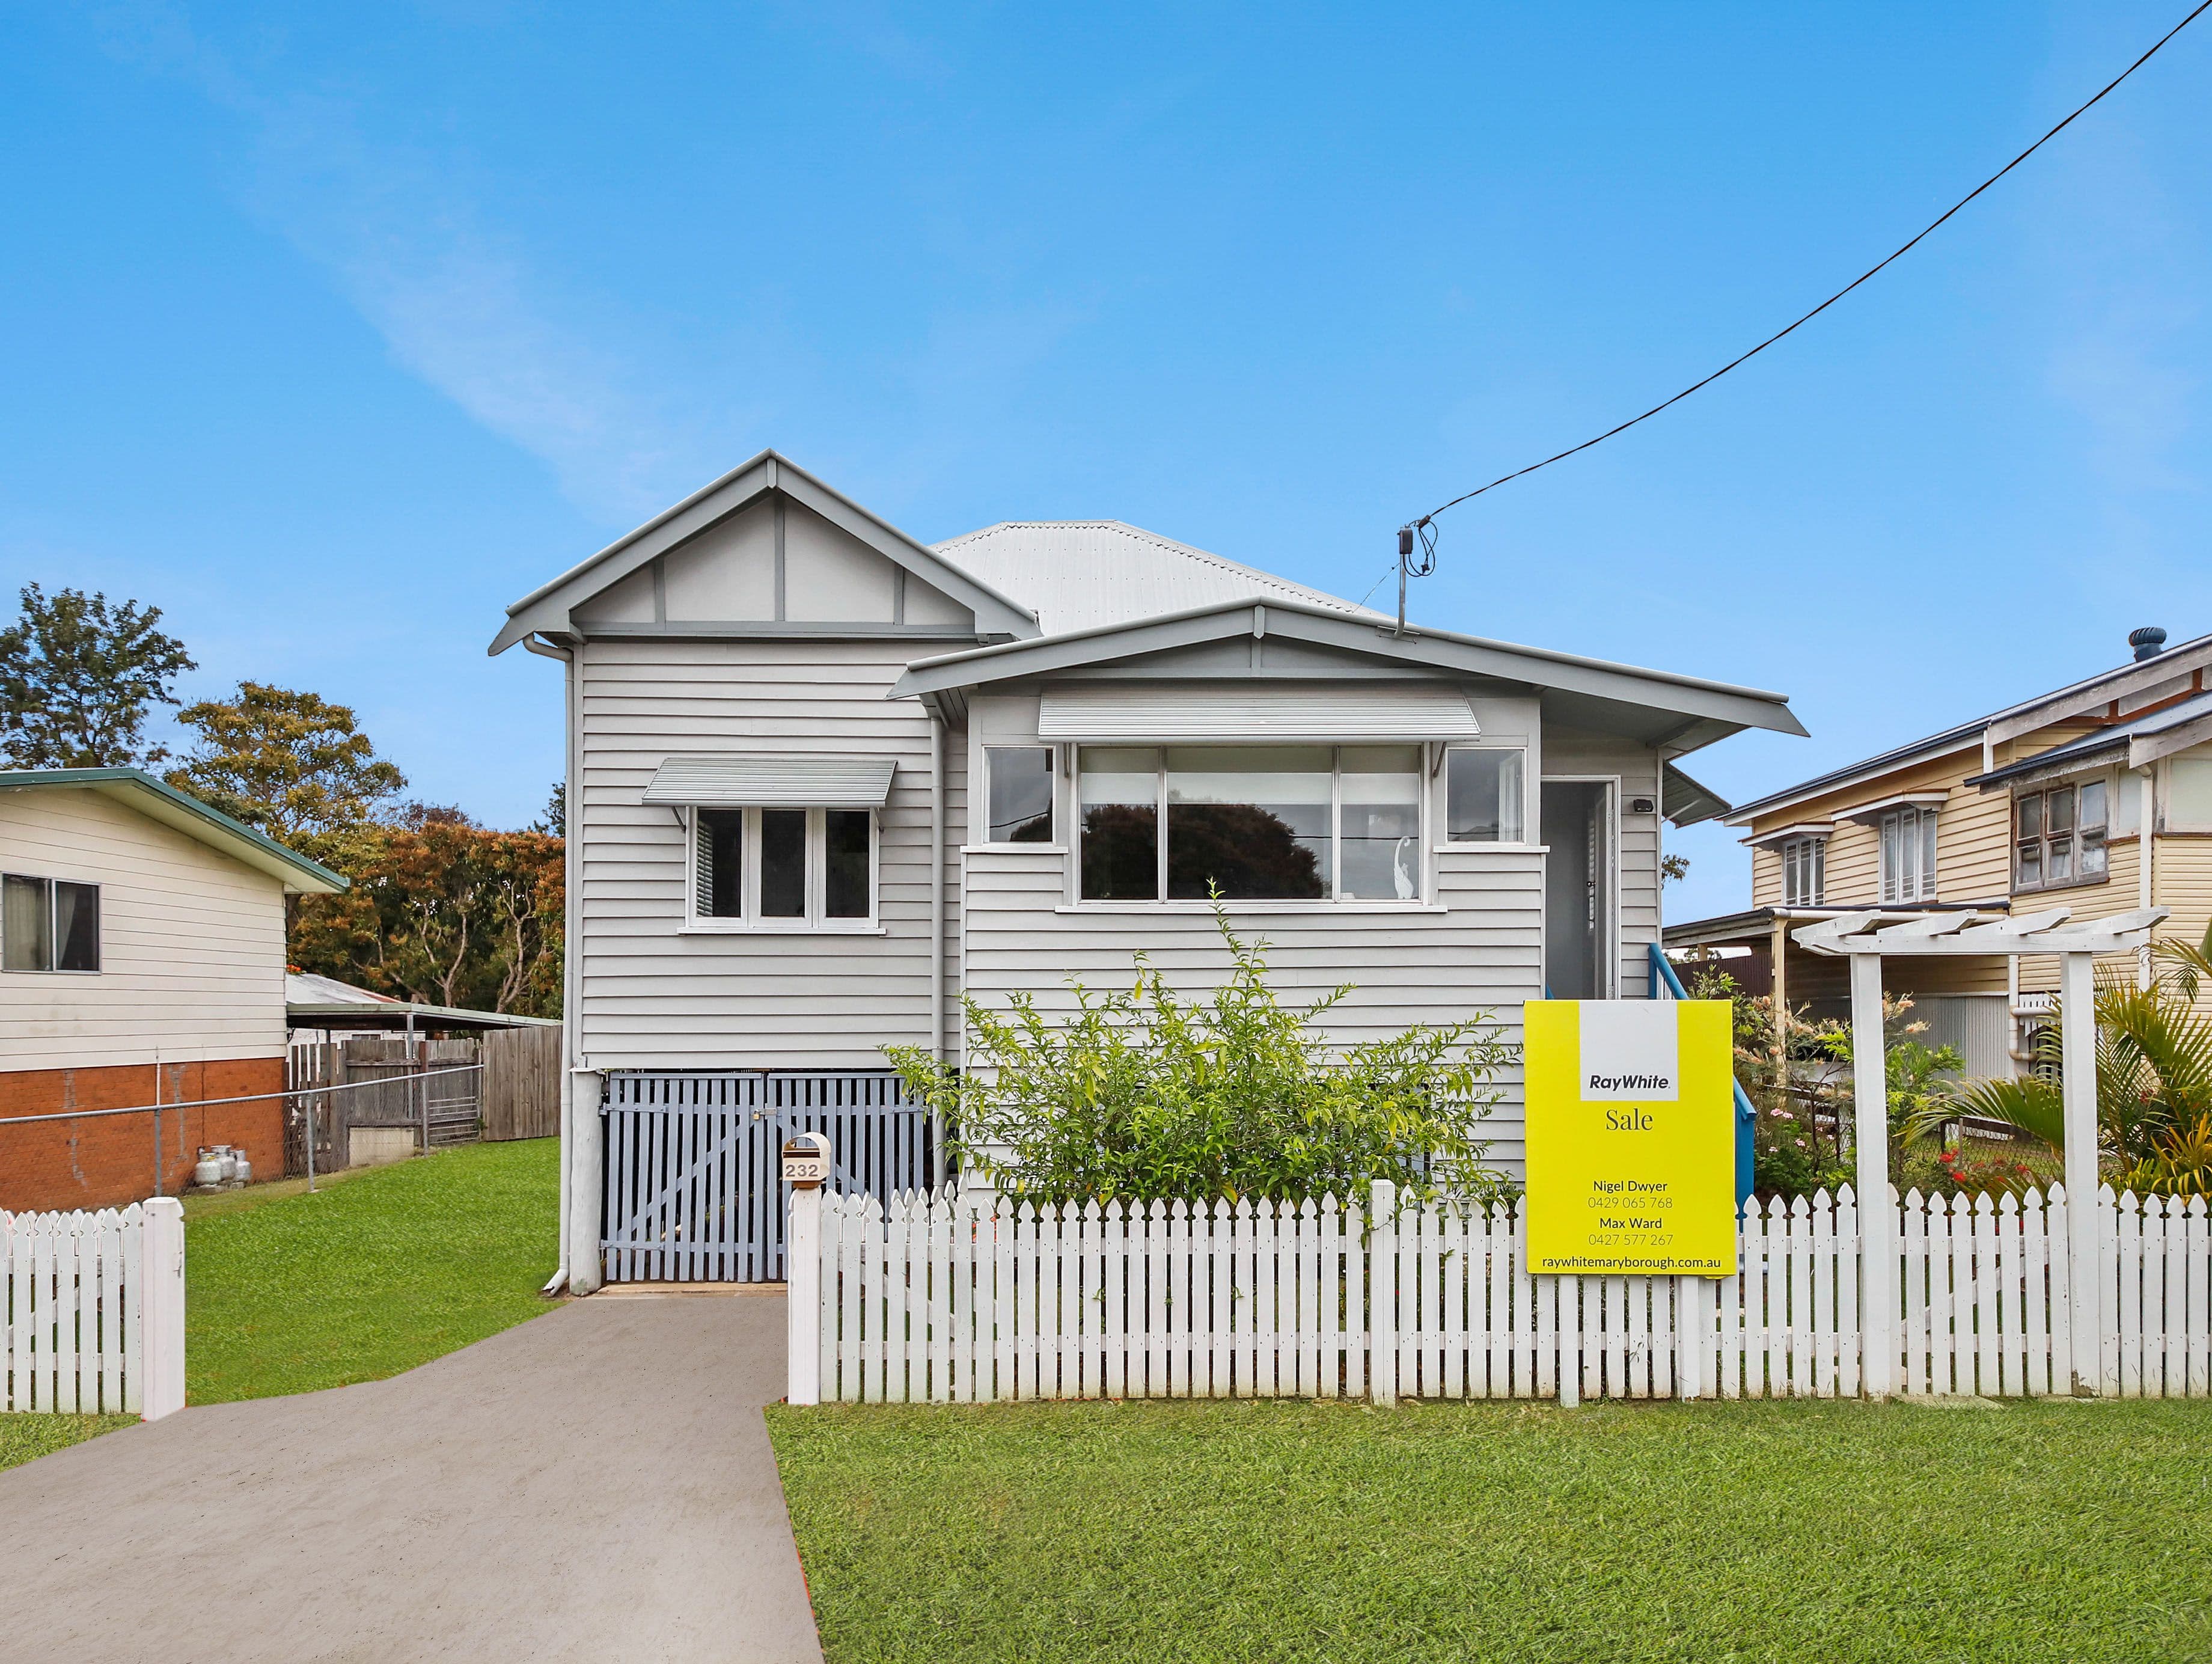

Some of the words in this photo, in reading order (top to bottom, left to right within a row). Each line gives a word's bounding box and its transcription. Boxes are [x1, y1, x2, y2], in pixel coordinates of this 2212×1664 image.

[1607, 1109, 1652, 1130] Sale
[786, 1164, 818, 1176] 232
[1594, 1181, 1624, 1193] Nigel
[1628, 1181, 1667, 1193] Dwyer
[1588, 1198, 1619, 1208] 0429
[1623, 1198, 1645, 1208] 065
[1650, 1198, 1672, 1208] 768
[1600, 1218, 1625, 1228] Max
[1629, 1218, 1661, 1228] Ward
[1589, 1234, 1619, 1245] 0427
[1624, 1235, 1646, 1245] 577
[1651, 1234, 1673, 1245] 267
[1543, 1256, 1720, 1270] raywhitemaryborough.com.au
